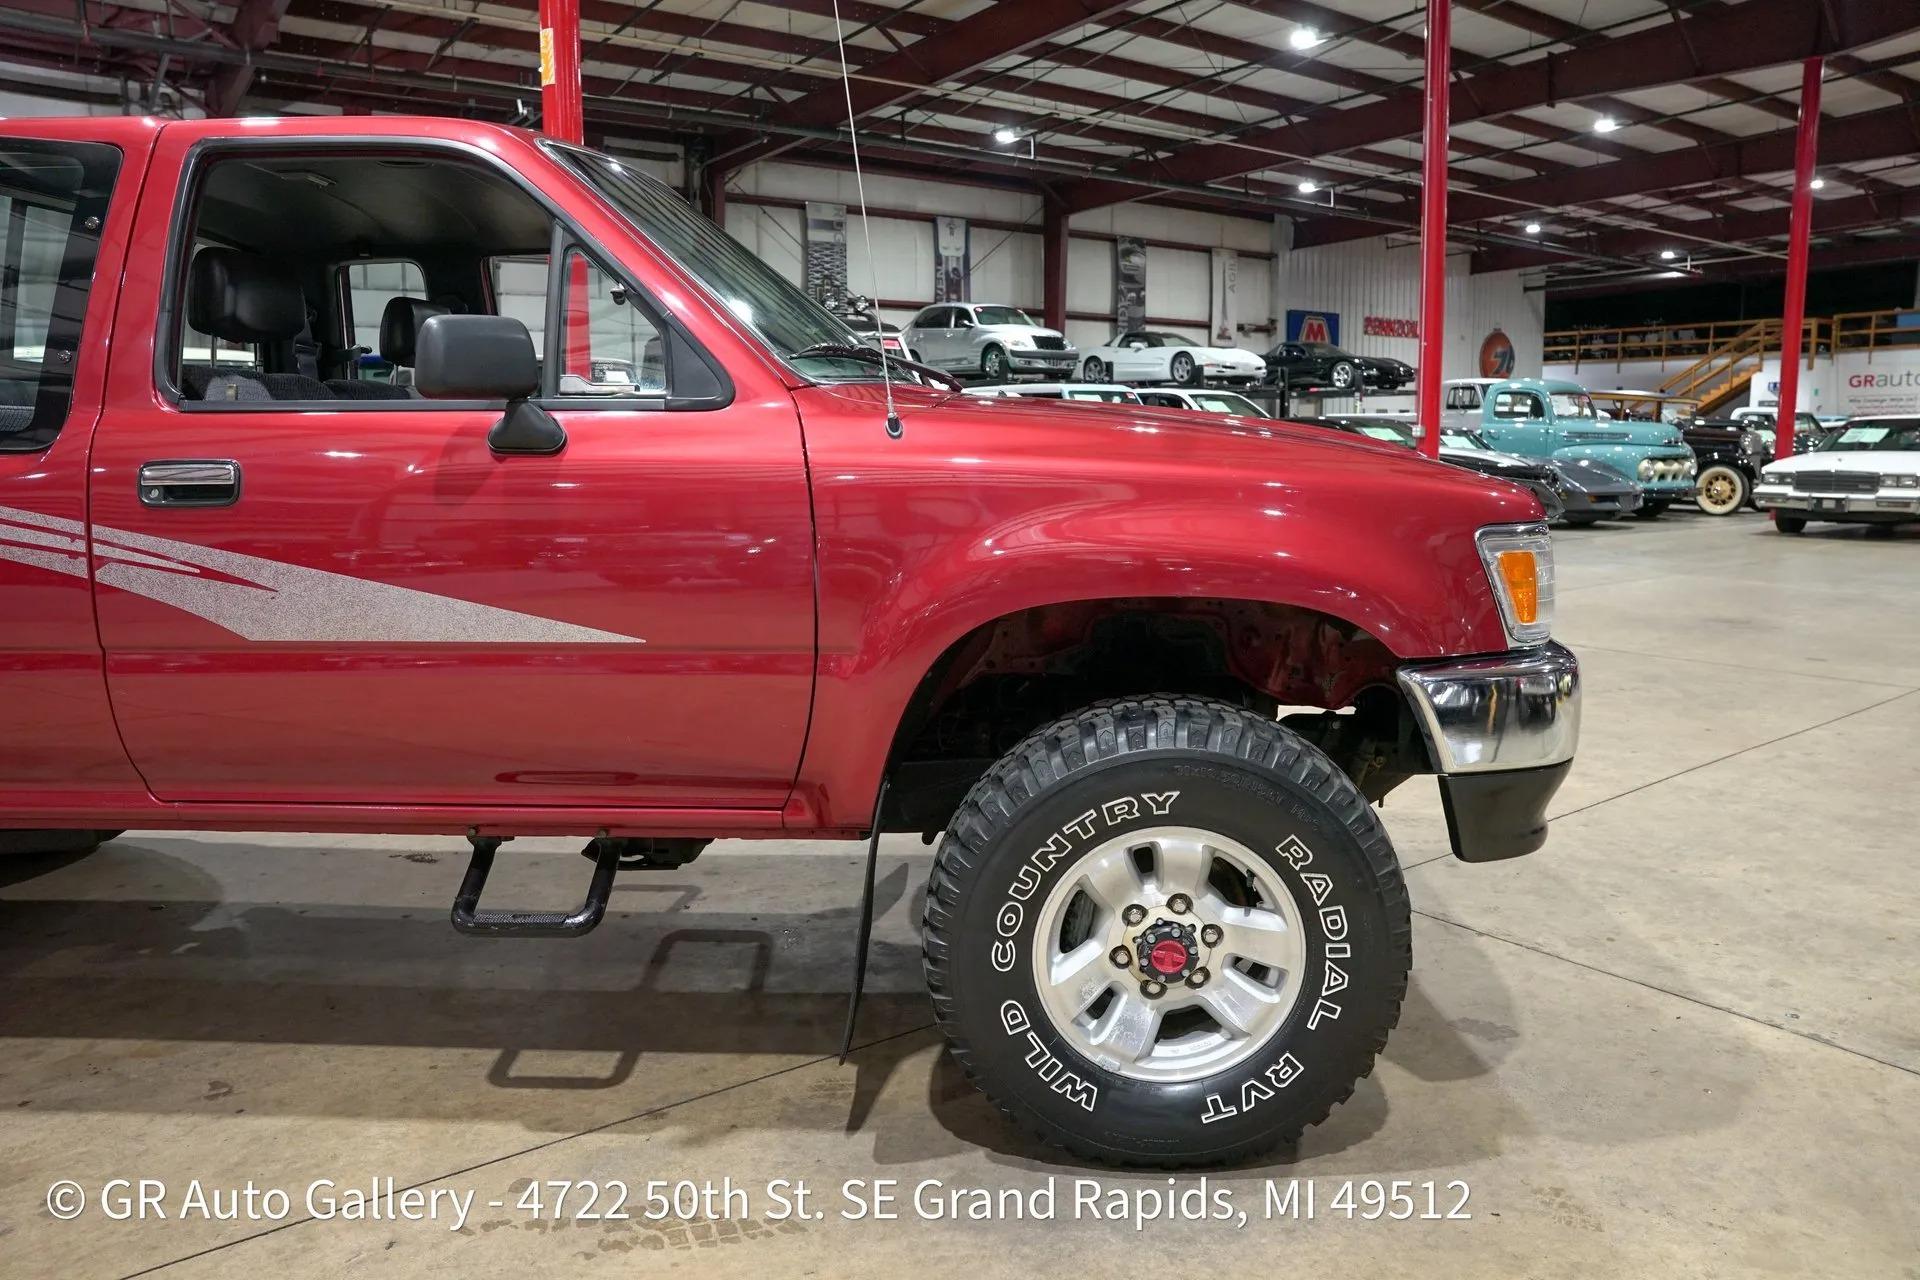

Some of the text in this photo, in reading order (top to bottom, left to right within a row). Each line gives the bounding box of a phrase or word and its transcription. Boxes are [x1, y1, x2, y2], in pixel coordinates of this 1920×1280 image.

[1303, 320, 1328, 342] M
[992, 791, 1181, 972] COUNTRY
[1201, 834, 1352, 1124] RADIAL RVT
[1000, 999, 1098, 1112] WILD
